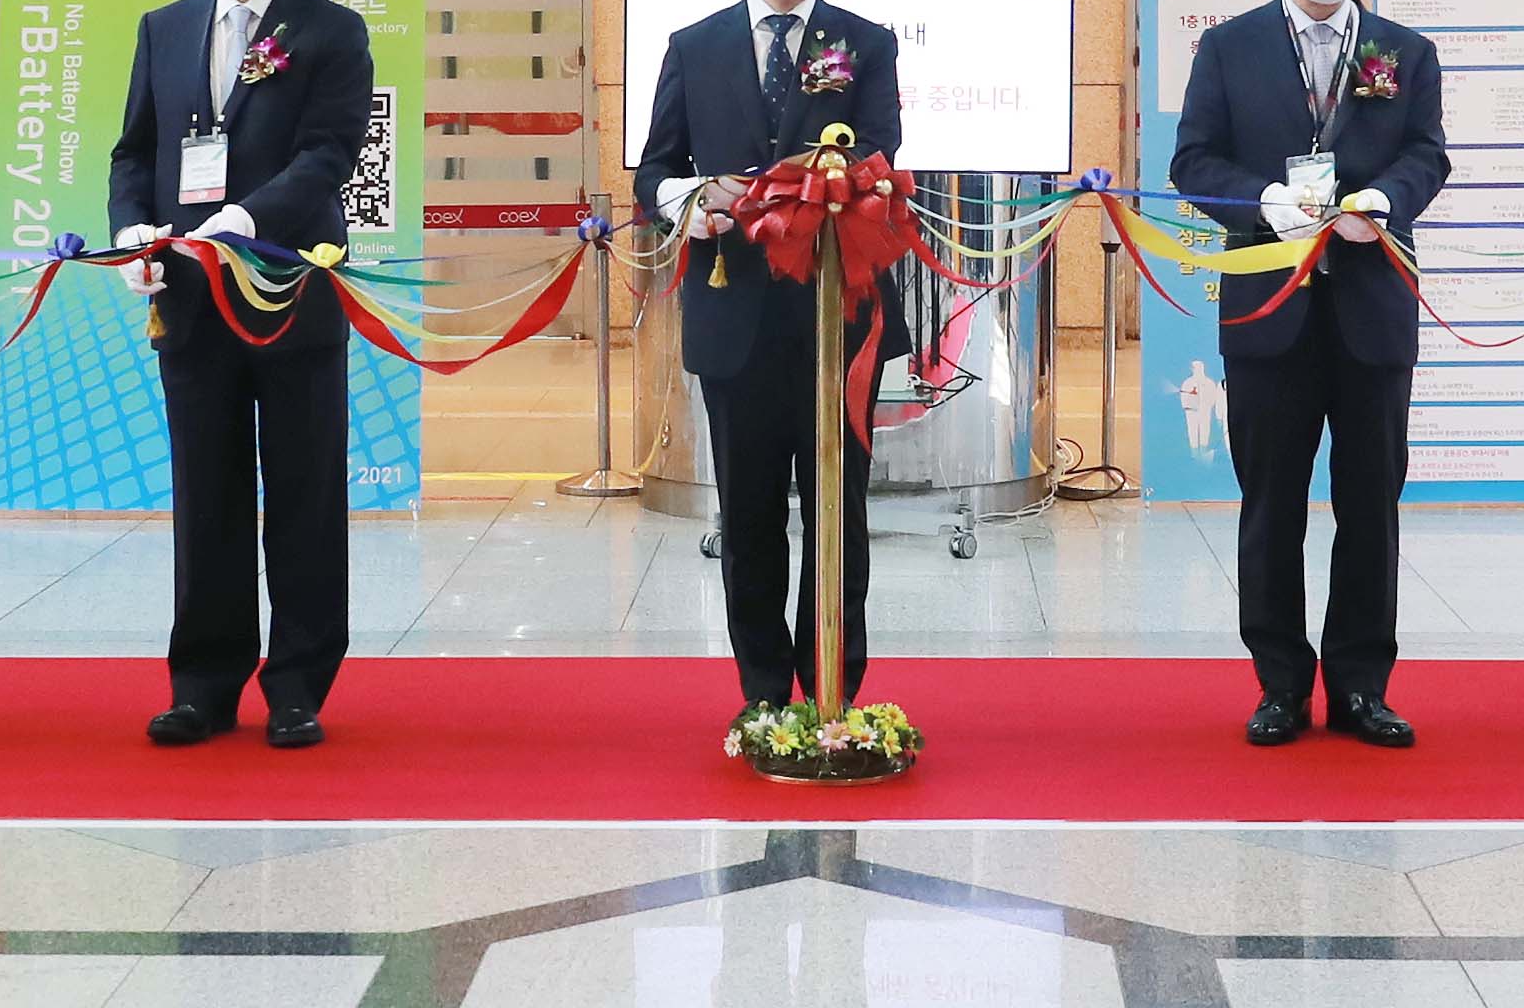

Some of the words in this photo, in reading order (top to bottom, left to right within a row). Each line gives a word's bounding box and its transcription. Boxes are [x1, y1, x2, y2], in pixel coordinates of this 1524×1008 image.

[63, 4, 85, 46] No.1
[56, 54, 82, 124] Battery
[58, 131, 80, 186] Show
[423, 207, 464, 225] coex
[498, 207, 541, 224] coex
[355, 242, 396, 254] Online
[358, 466, 402, 484] 2021
